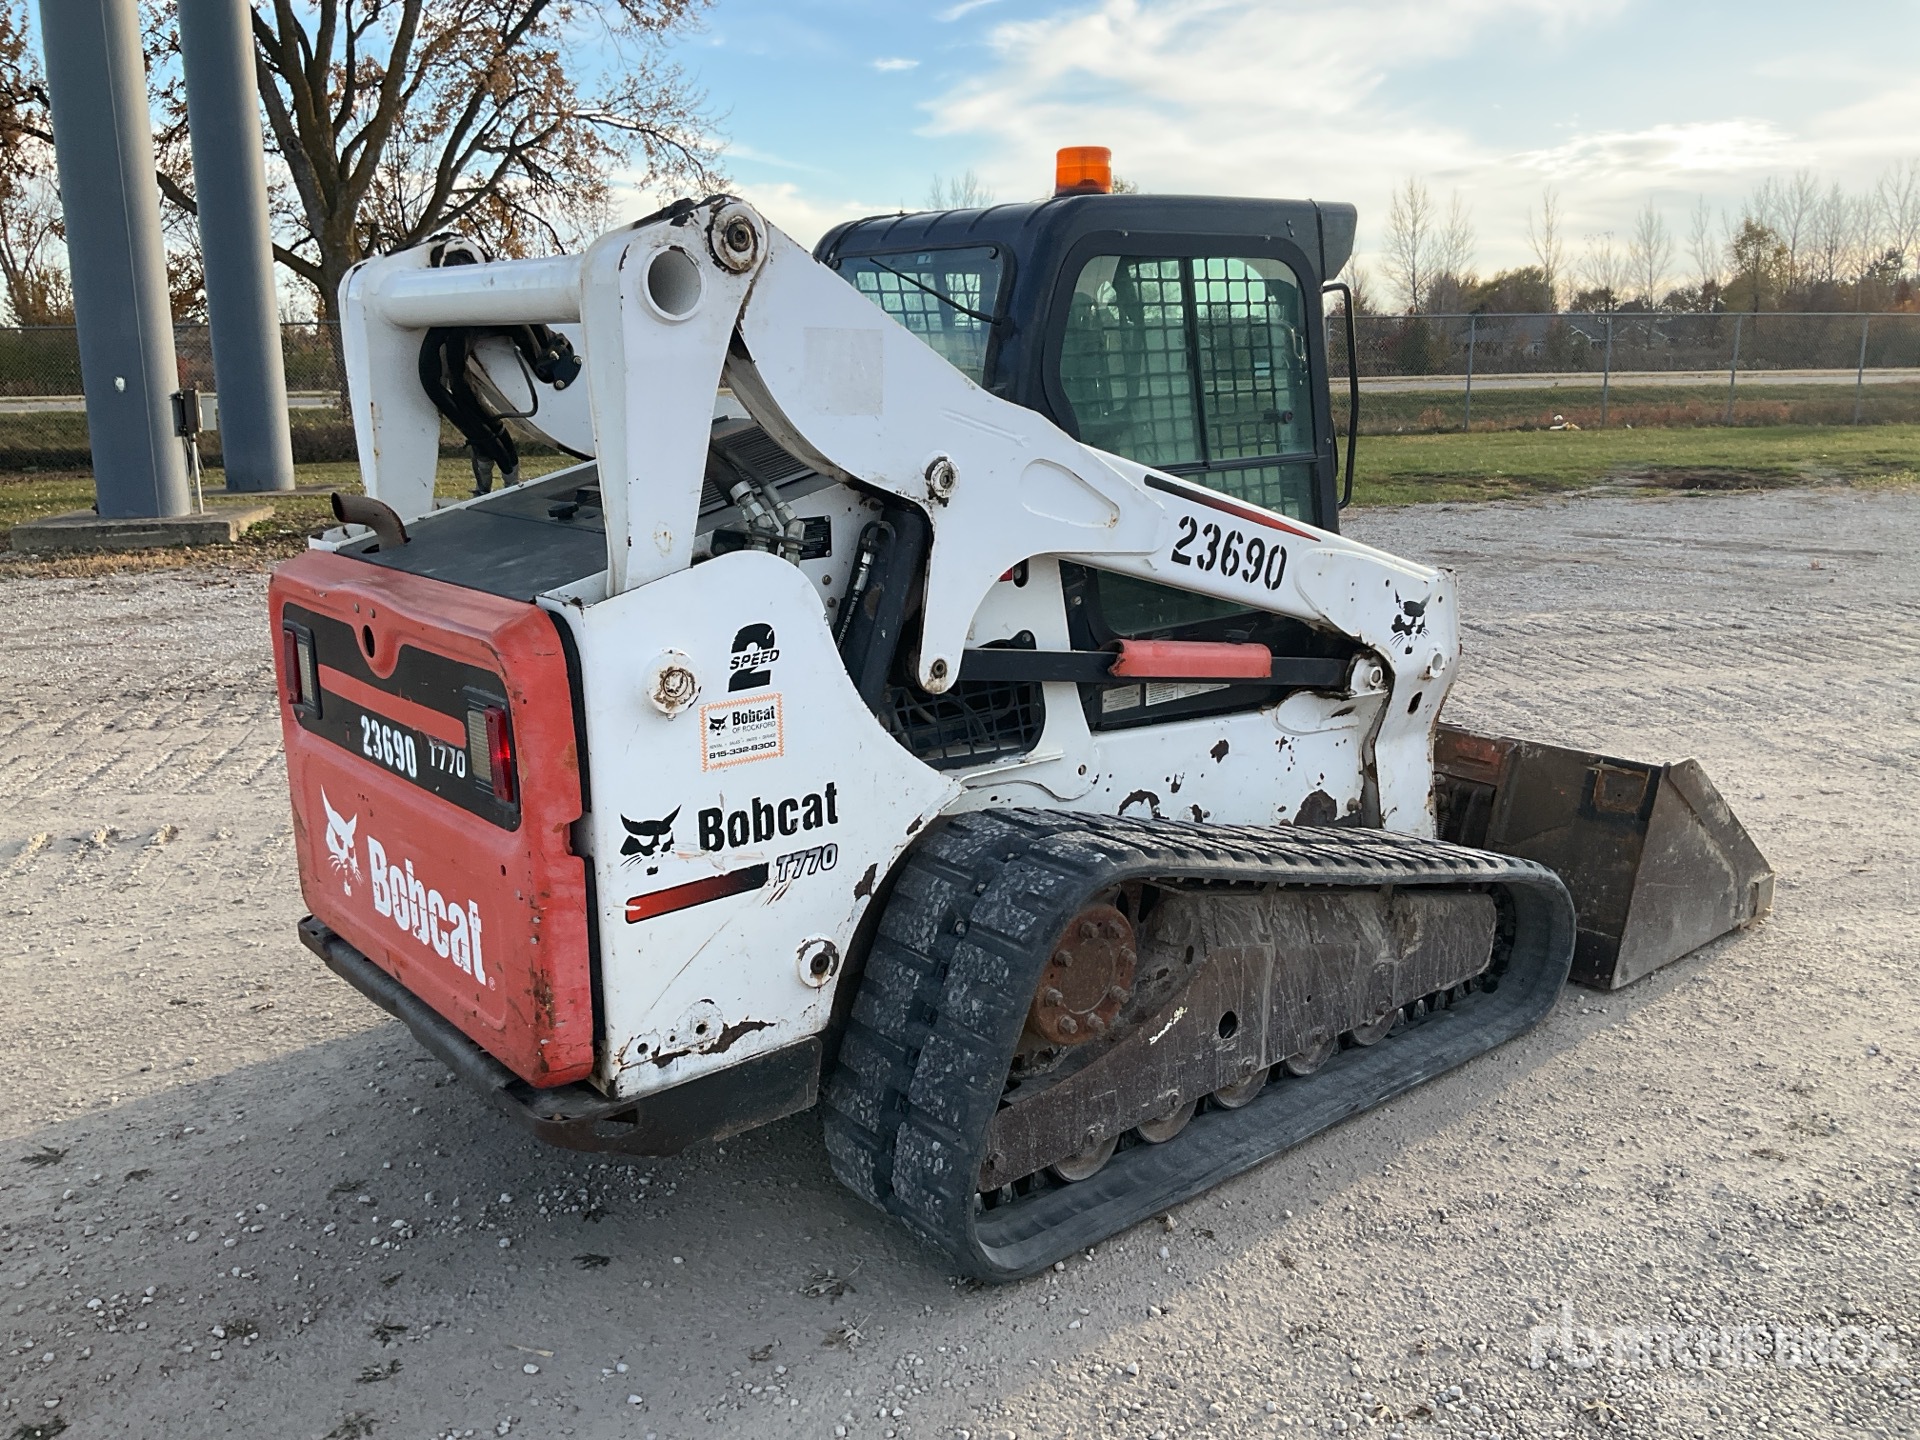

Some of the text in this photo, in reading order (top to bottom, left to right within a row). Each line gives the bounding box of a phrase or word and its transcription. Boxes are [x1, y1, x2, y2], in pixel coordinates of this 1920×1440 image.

[1170, 514, 1288, 592] 23690
[728, 622, 776, 693] 2
[729, 648, 780, 671] SPEED
[732, 705, 775, 726] Bobcat
[742, 720, 776, 733] ROCKFORD
[360, 714, 466, 779] 23690 T770
[709, 741, 776, 759] 815-332-8300
[698, 781, 839, 853] Bobcat
[776, 842, 838, 884] T770
[366, 834, 487, 986] Bobcat
